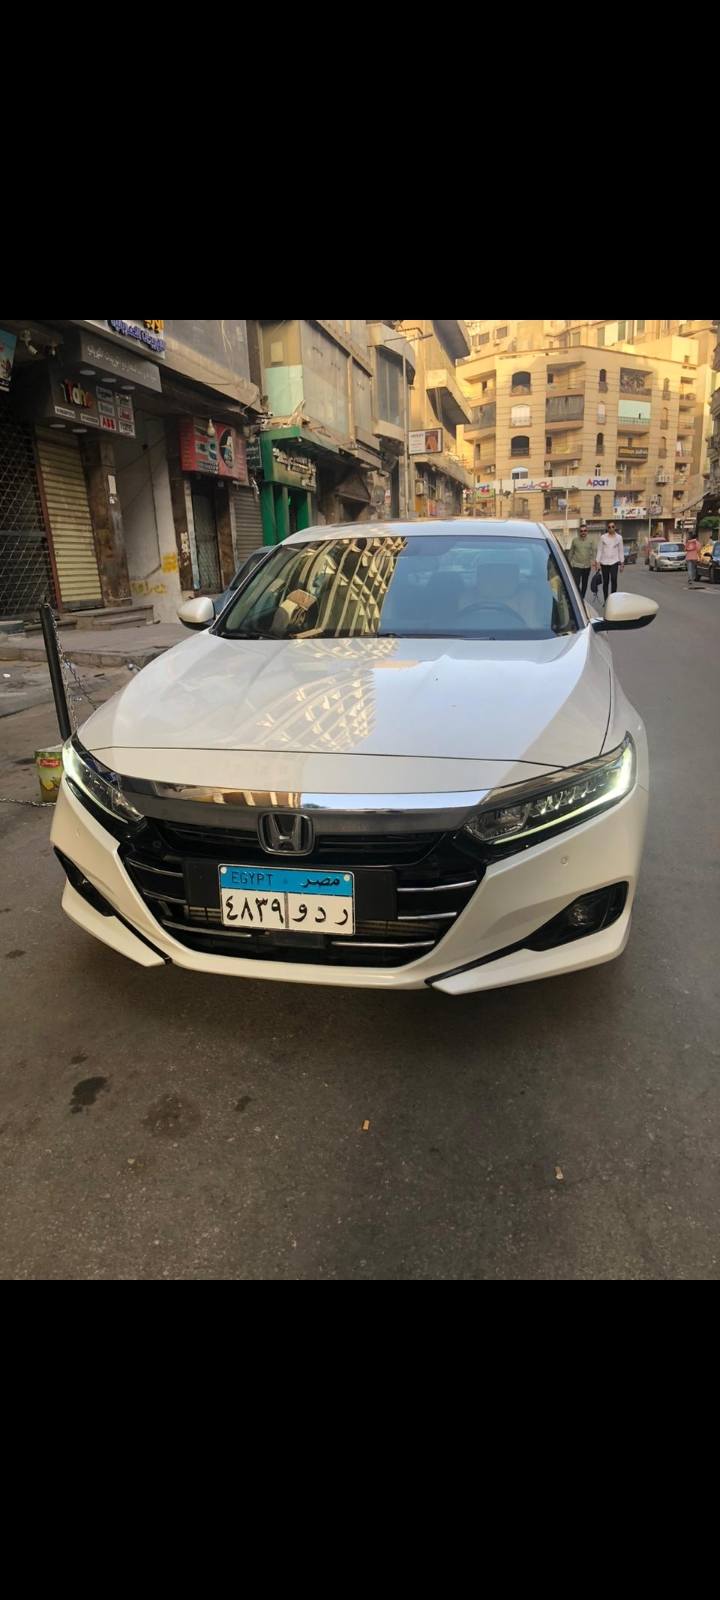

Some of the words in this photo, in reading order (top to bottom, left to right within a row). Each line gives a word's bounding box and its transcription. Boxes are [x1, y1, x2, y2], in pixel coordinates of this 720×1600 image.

[586, 477, 609, 488] Apart
[231, 871, 273, 887] EGYPT
[300, 876, 341, 889] مصر
[225, 895, 284, 924] ٤٨٣٩
